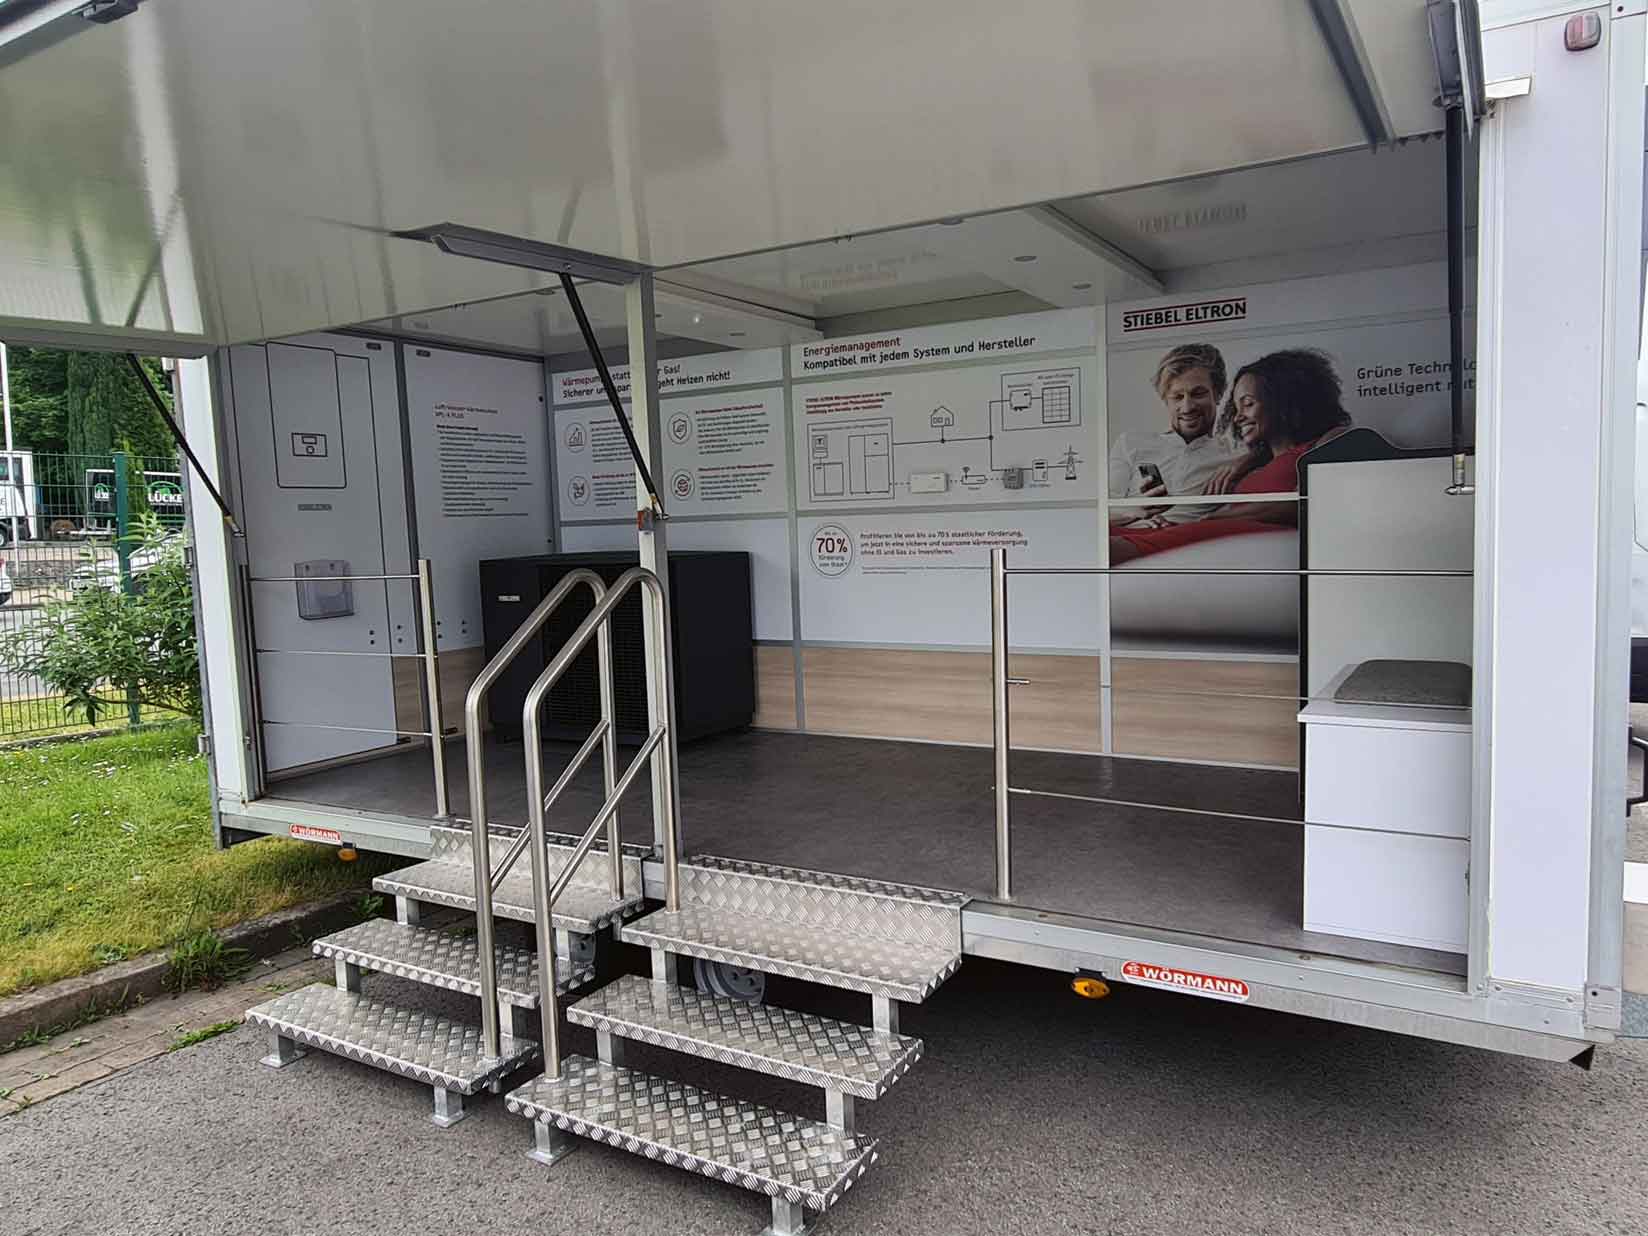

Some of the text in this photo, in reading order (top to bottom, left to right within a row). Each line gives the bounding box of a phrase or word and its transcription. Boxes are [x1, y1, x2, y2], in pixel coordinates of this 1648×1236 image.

[1123, 301, 1247, 328] STIEBEL ELTRON
[803, 337, 901, 357] Energiemanagement
[803, 336, 1036, 370] Kompatibel mit jedem System und Hersteller
[611, 370, 631, 381] statt
[663, 364, 681, 375] Gas!
[1357, 365, 1402, 380] Grüne
[563, 387, 594, 398] Sicherer
[677, 375, 704, 385] Heizen
[706, 370, 731, 382] nicht!
[1356, 381, 1441, 397] intelligent
[148, 490, 183, 503] LÜCKE
[299, 826, 338, 841] WÖRMANN
[1142, 965, 1243, 995] WÖRMANN
